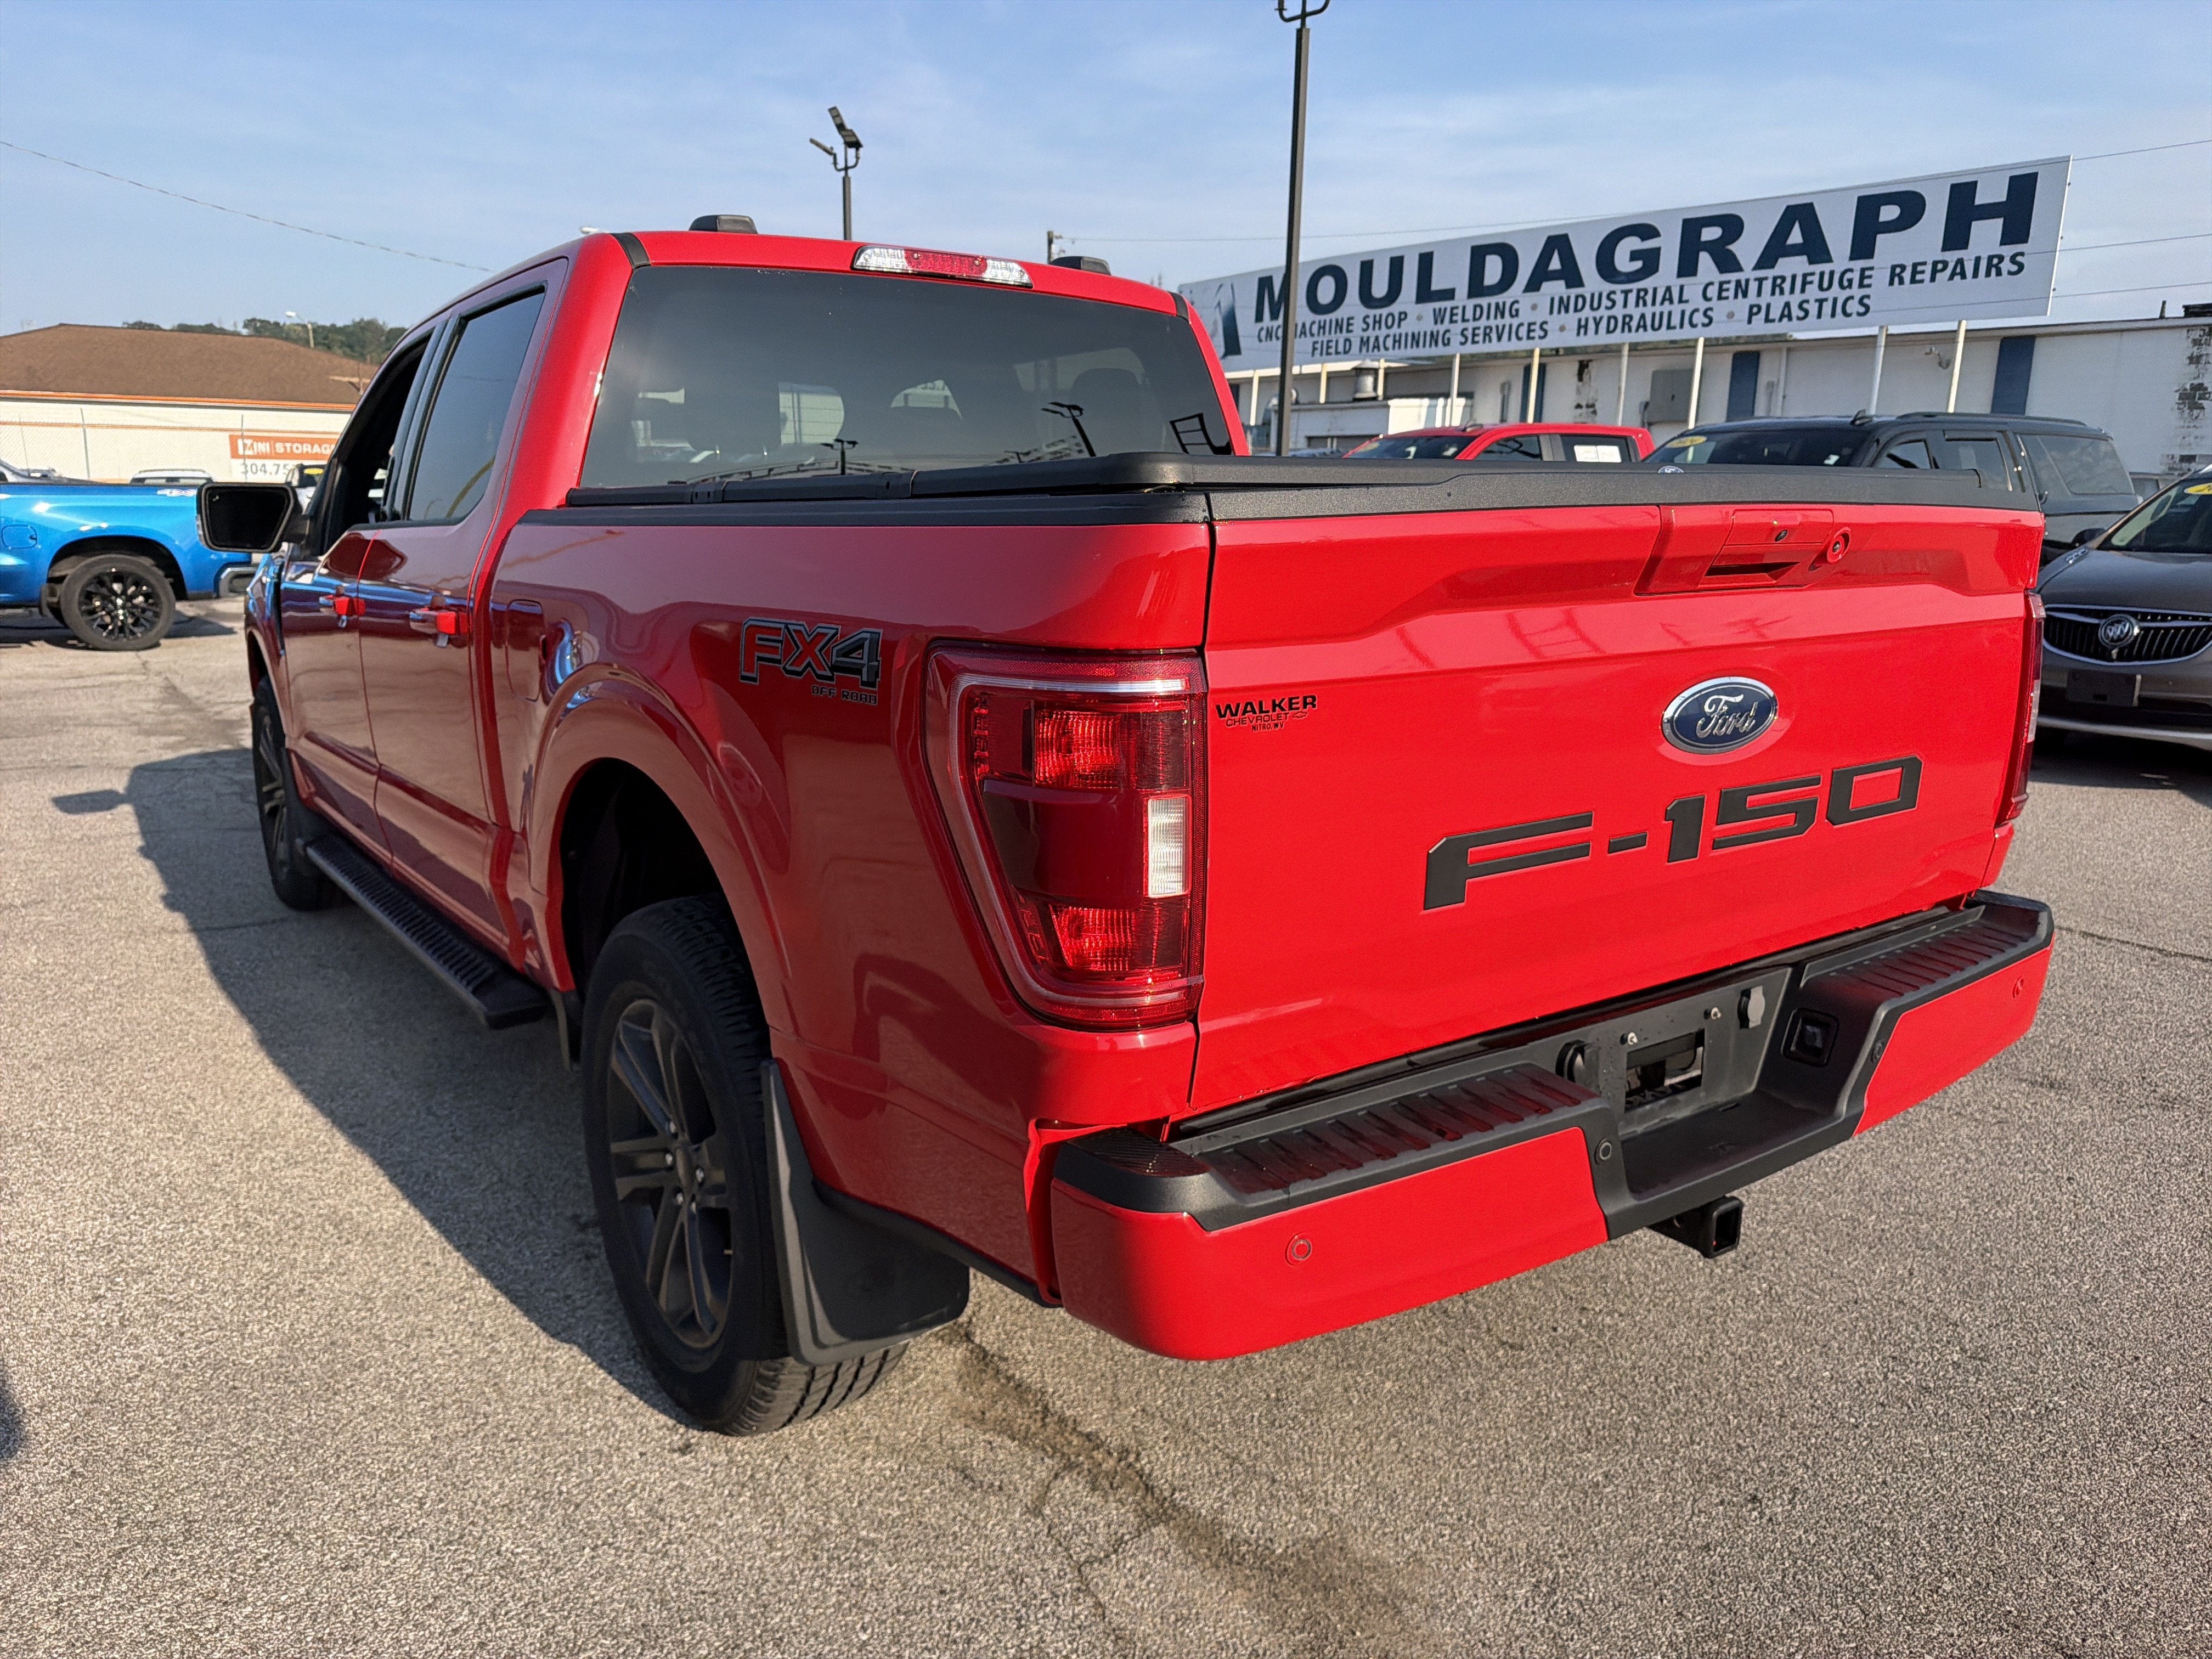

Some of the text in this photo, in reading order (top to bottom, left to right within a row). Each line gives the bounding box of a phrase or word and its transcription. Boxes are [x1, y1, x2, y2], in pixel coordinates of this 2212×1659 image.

[1255, 172, 2039, 324] MOULDAGRAPH
[1257, 325, 1281, 343] CNC
[1362, 311, 1408, 332] SHOP
[1432, 300, 1521, 326] WELDING
[1549, 284, 1689, 315] INDUSTRIAL
[1702, 266, 1875, 302] CENTRIFUGE
[1888, 251, 2025, 286] REPAIRS
[1311, 294, 1871, 357] FIELD MACHINING SERVICES HYDRAULICS PLASTICS
[740, 617, 883, 689] FX4
[811, 685, 878, 706] OFF ROAD
[1215, 695, 1317, 719] WALKER
[1226, 713, 1289, 727] CHEVROLET
[1696, 693, 1758, 738] Ford
[1423, 755, 1923, 911] F-150
